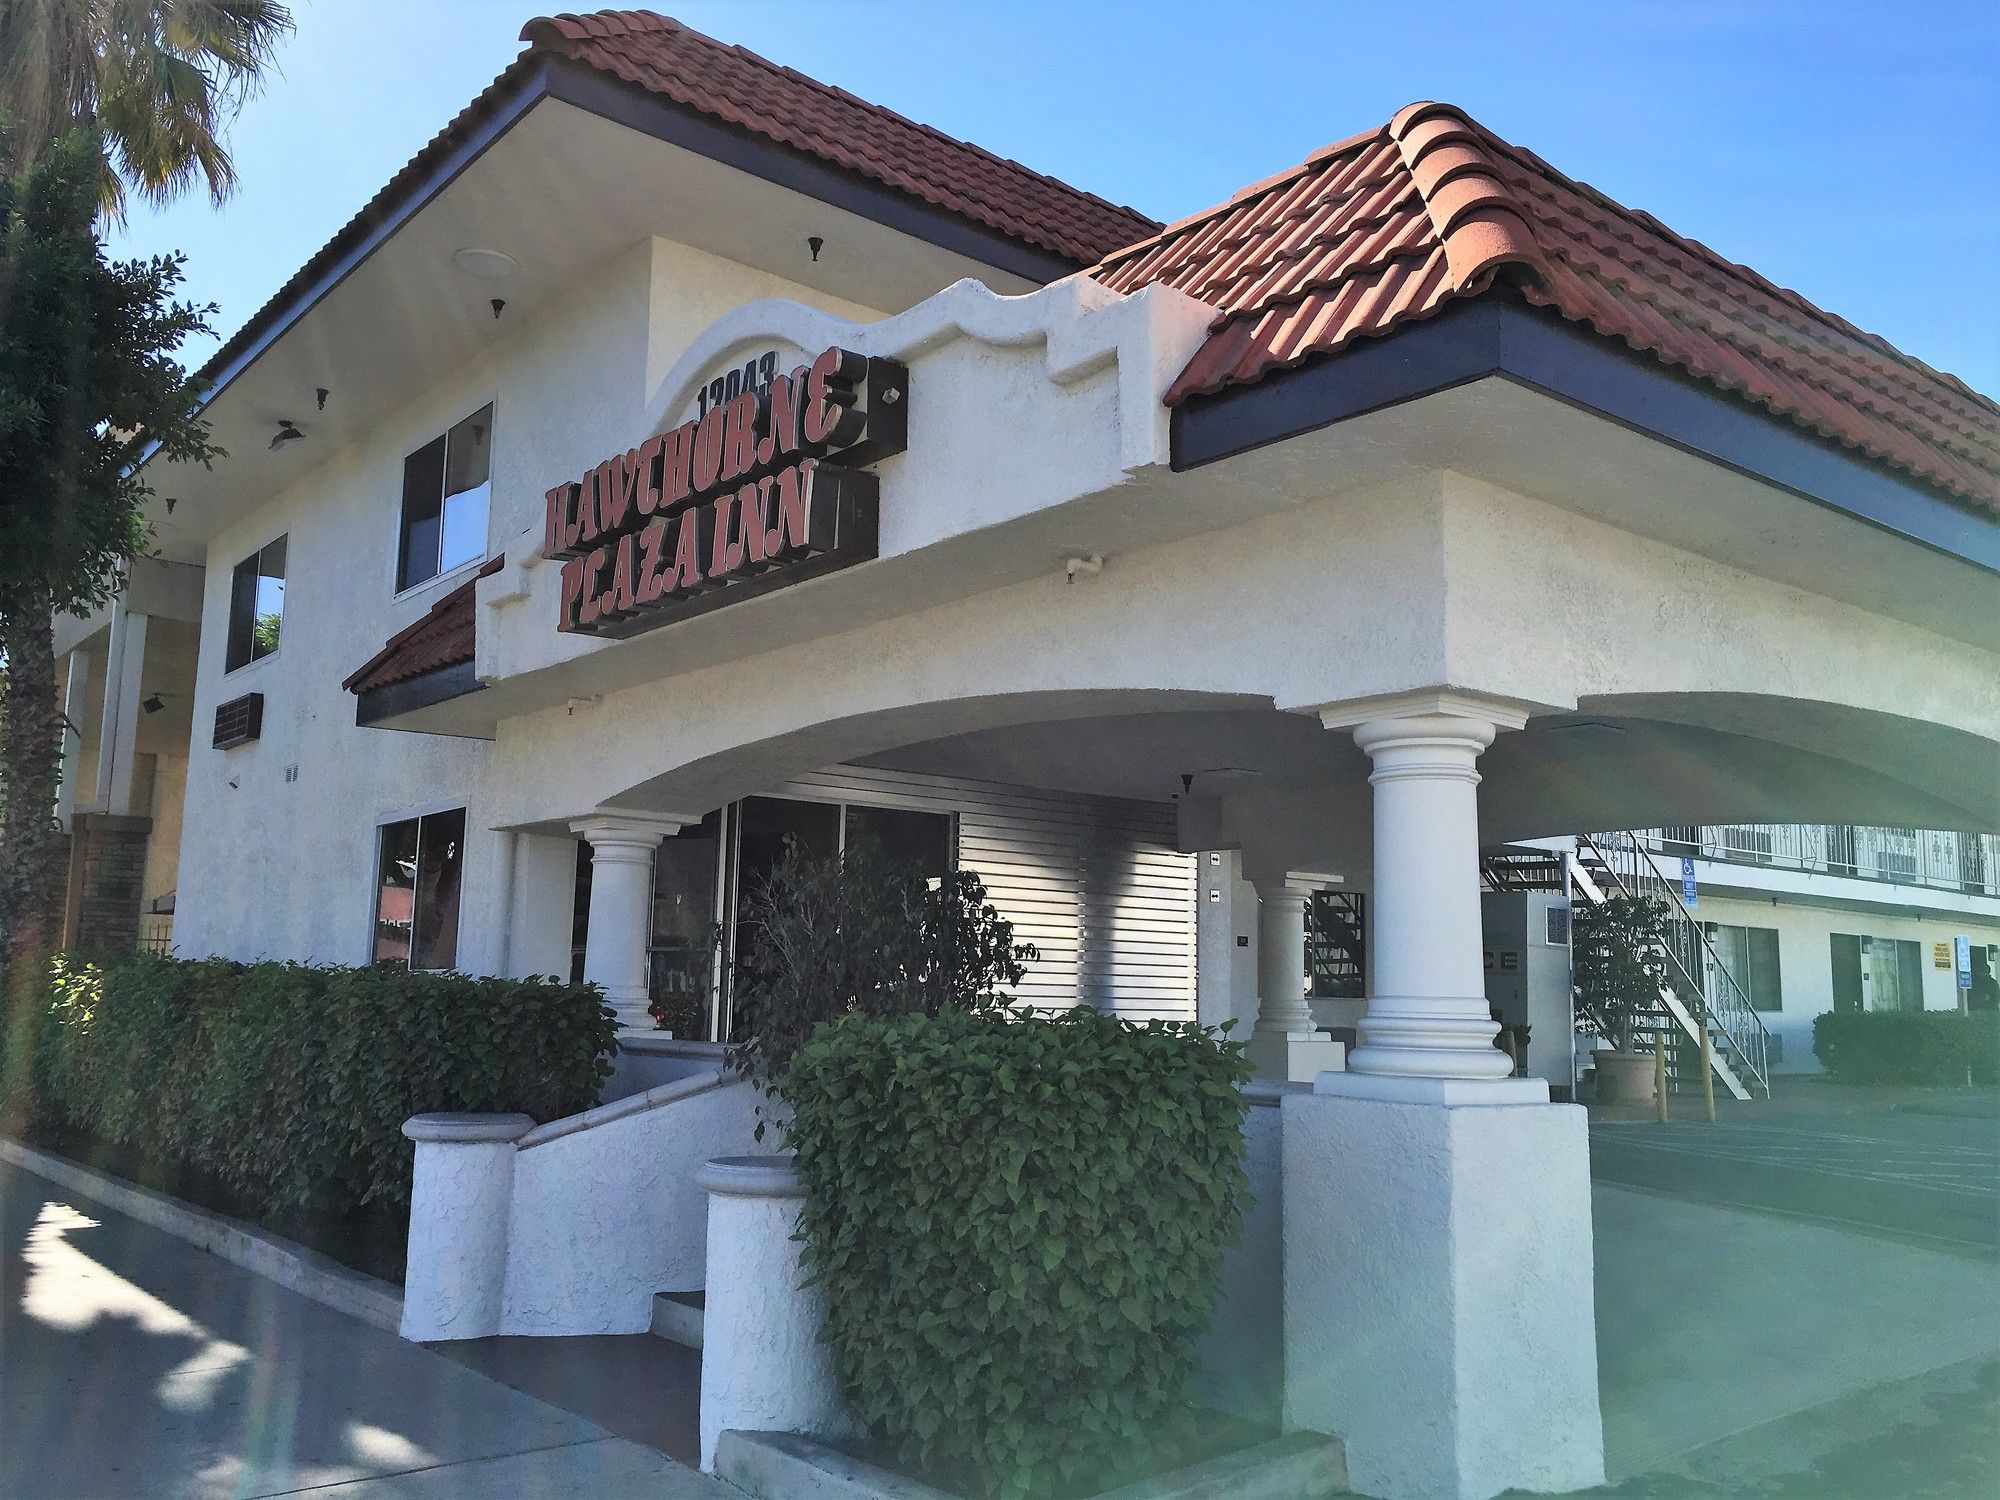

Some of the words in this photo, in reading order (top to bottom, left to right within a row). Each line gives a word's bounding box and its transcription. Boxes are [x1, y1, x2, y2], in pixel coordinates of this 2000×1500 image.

[543, 346, 841, 558] HAWTHORNE
[557, 507, 703, 632] PLAZA
[708, 458, 818, 578] INN
